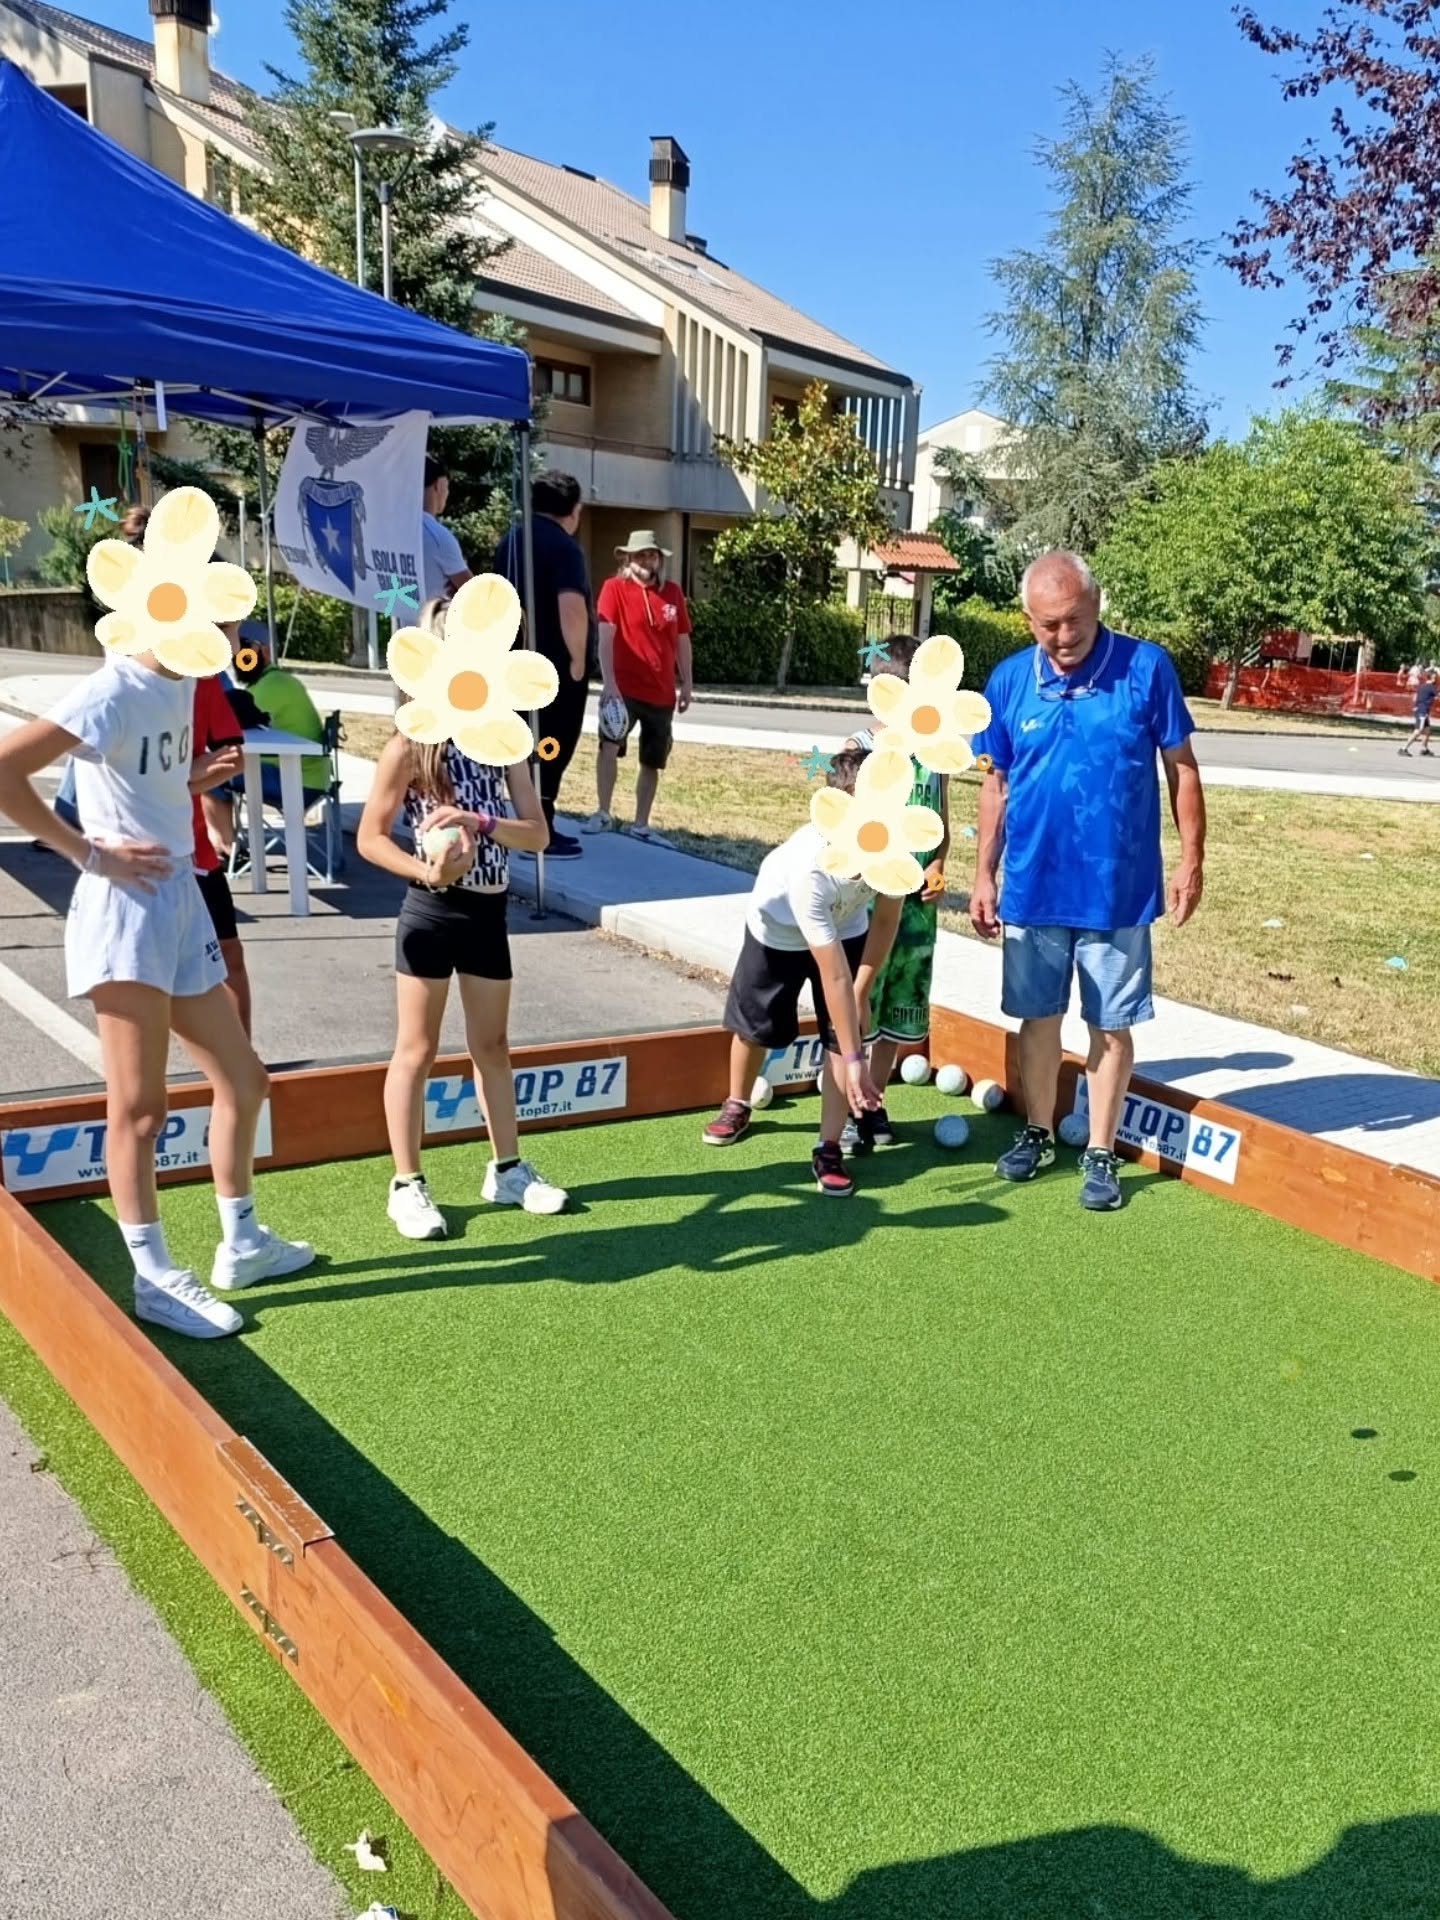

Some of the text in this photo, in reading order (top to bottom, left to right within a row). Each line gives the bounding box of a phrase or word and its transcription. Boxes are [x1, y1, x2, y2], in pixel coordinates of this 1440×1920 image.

[399, 553, 417, 577] DEL
[793, 1040, 824, 1069] TO
[515, 1062, 621, 1105] OP 87
[84, 1115, 186, 1163] TP
[1123, 1096, 1236, 1163] TOP 87
